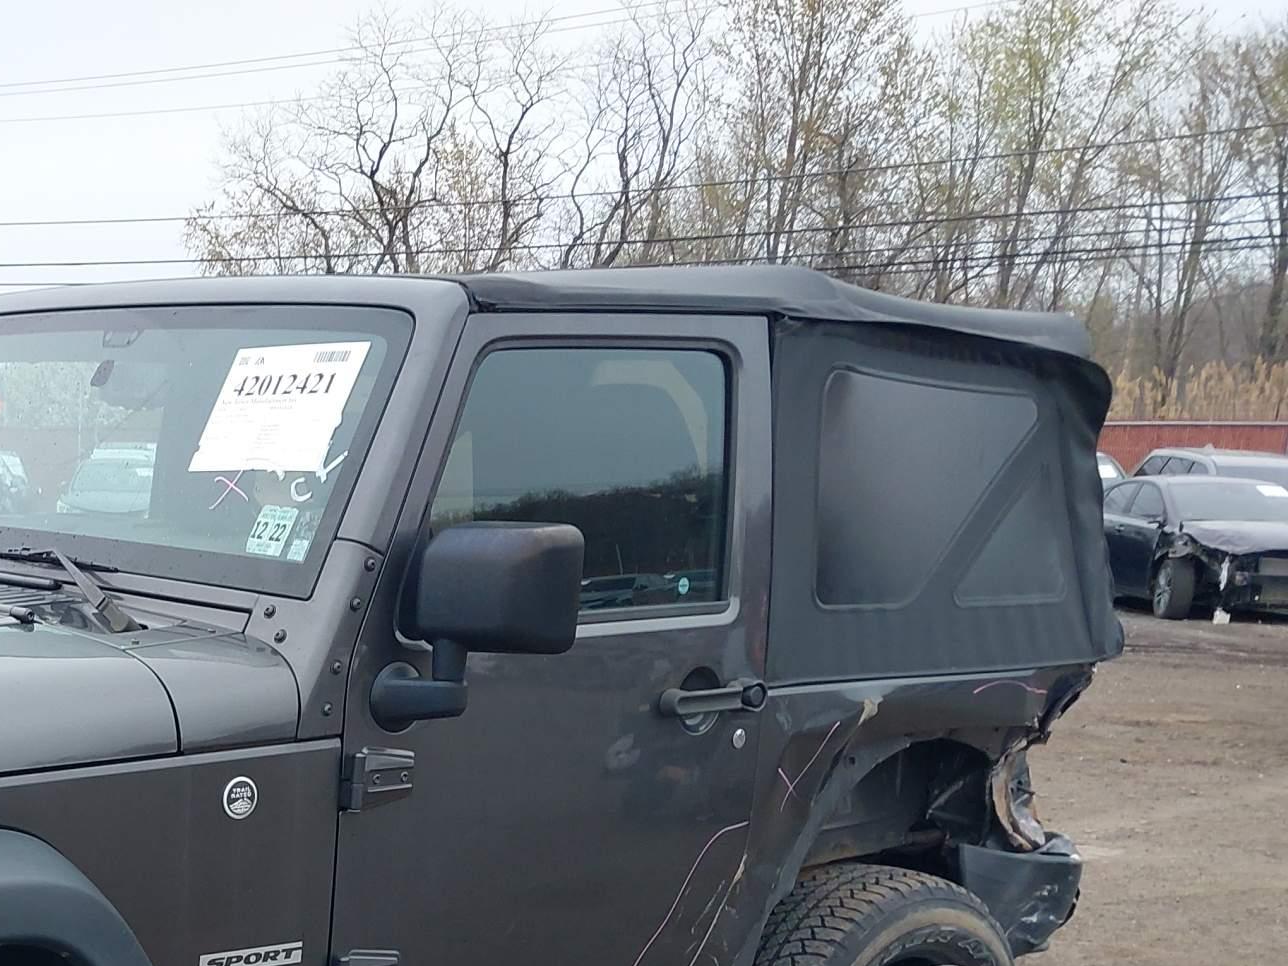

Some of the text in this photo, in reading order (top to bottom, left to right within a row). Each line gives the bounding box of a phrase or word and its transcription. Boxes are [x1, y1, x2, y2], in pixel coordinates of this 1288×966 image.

[233, 372, 337, 396] 42012421
[250, 520, 287, 542] 12 22
